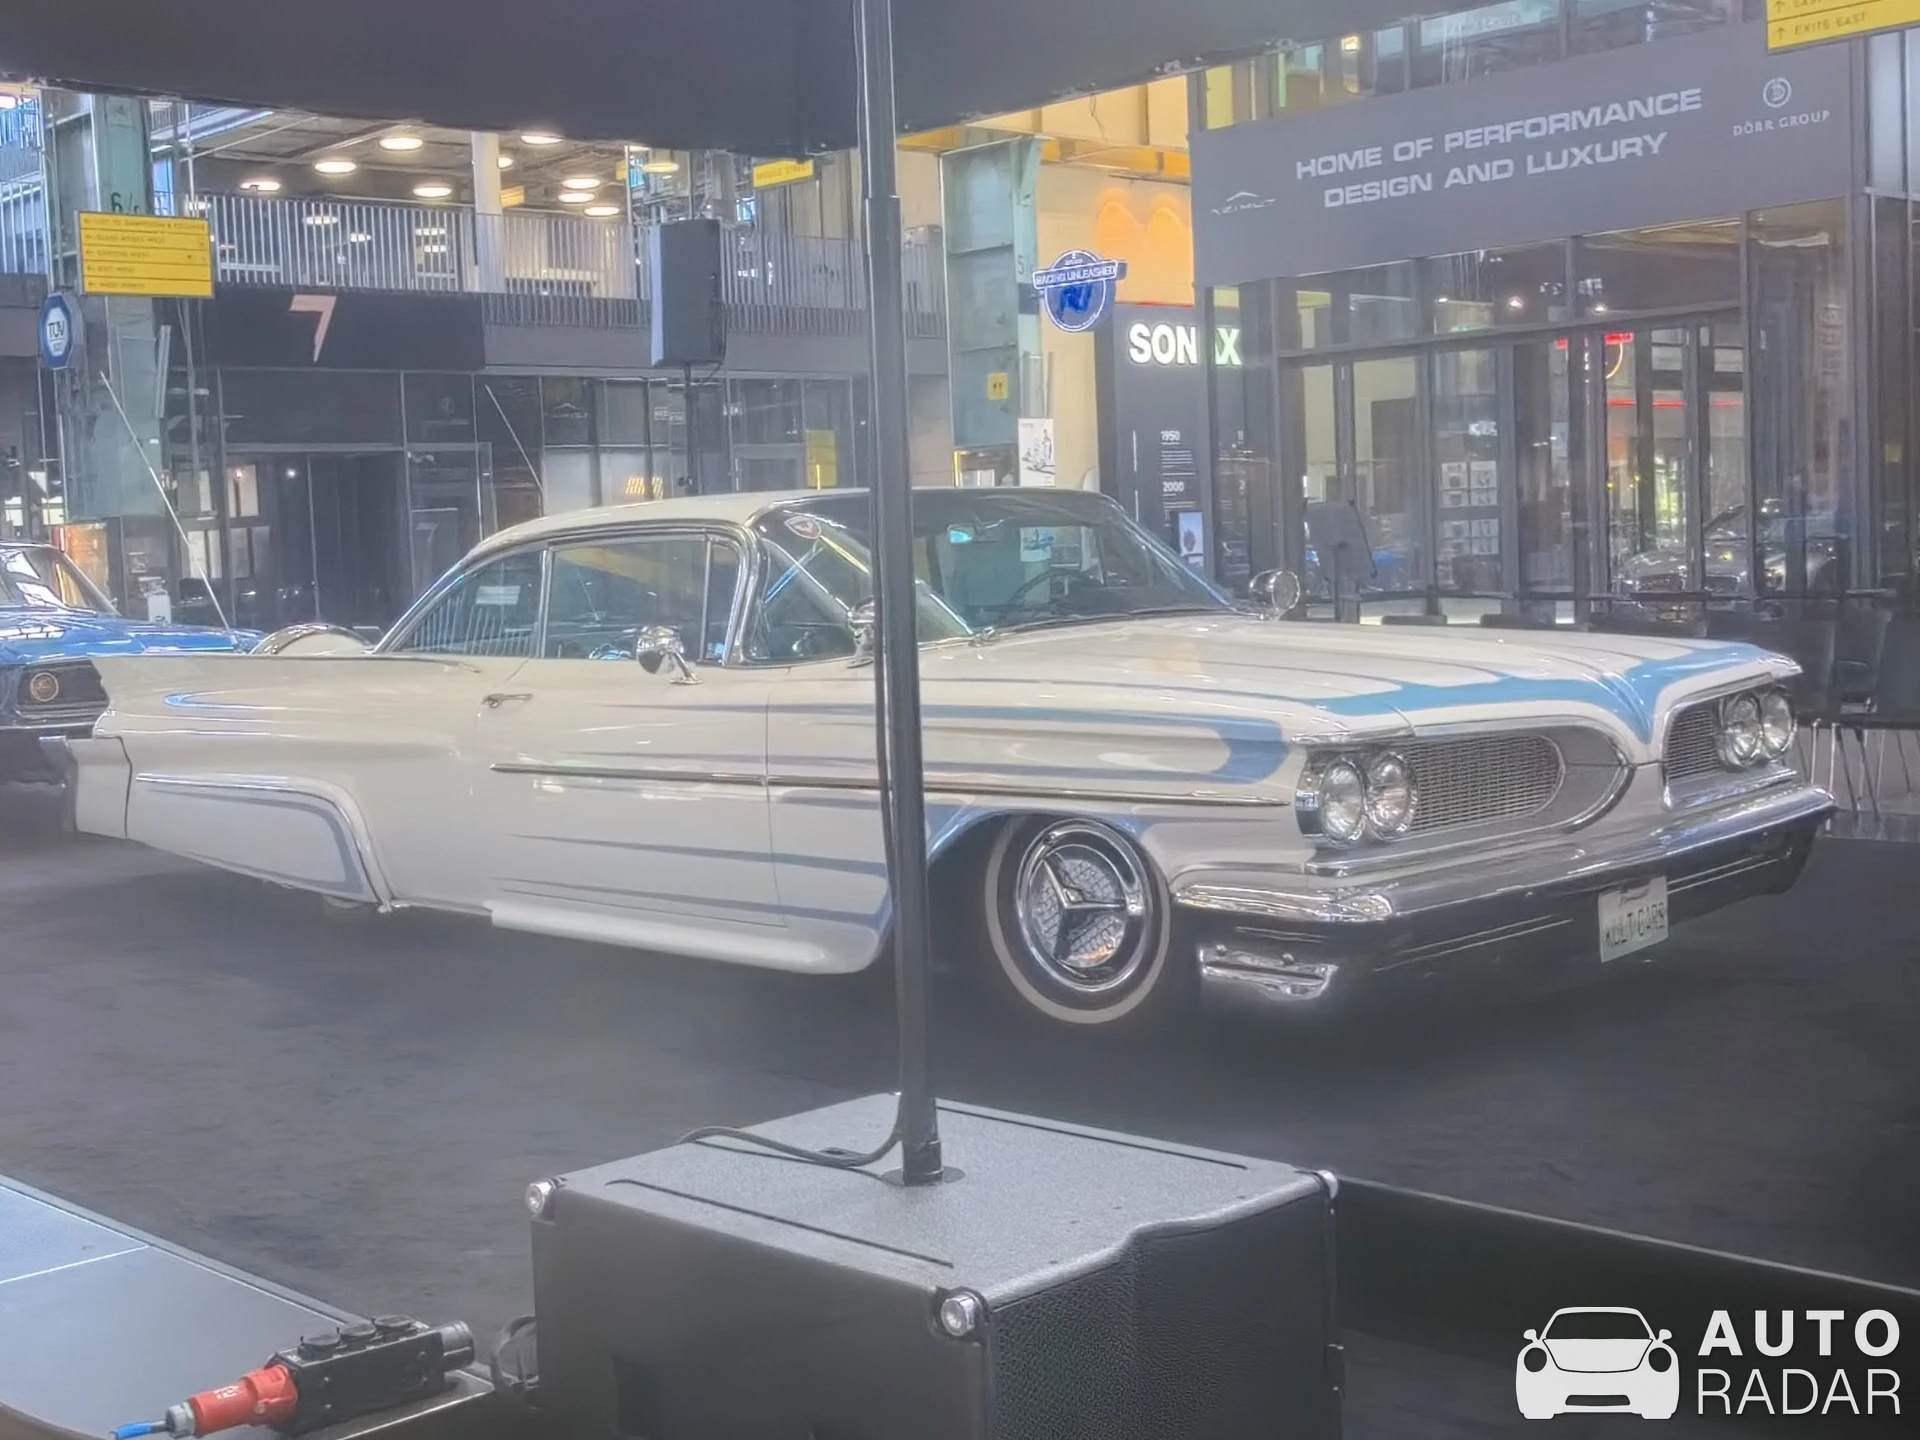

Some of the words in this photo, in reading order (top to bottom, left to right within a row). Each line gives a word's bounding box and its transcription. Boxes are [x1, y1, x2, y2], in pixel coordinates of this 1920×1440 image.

[1794, 19, 1830, 35] EXITS
[1836, 12, 1866, 27] EAST
[1296, 146, 1382, 181] HOME
[1393, 137, 1433, 162] OF
[1444, 88, 1702, 154] PERFORMANCE
[1732, 119, 1774, 136] DÖRR
[1778, 109, 1830, 128] GROUP
[1324, 172, 1432, 208] DESIGN
[1443, 158, 1514, 189] AND
[1526, 132, 1668, 176] LUXURY
[1036, 272, 1066, 286] RACING
[1066, 265, 1116, 282] UNLEASHED
[288, 294, 338, 363] 7
[1128, 322, 1243, 366] SONX
[1160, 430, 1180, 441] 1950
[1162, 481, 1185, 492] 2000
